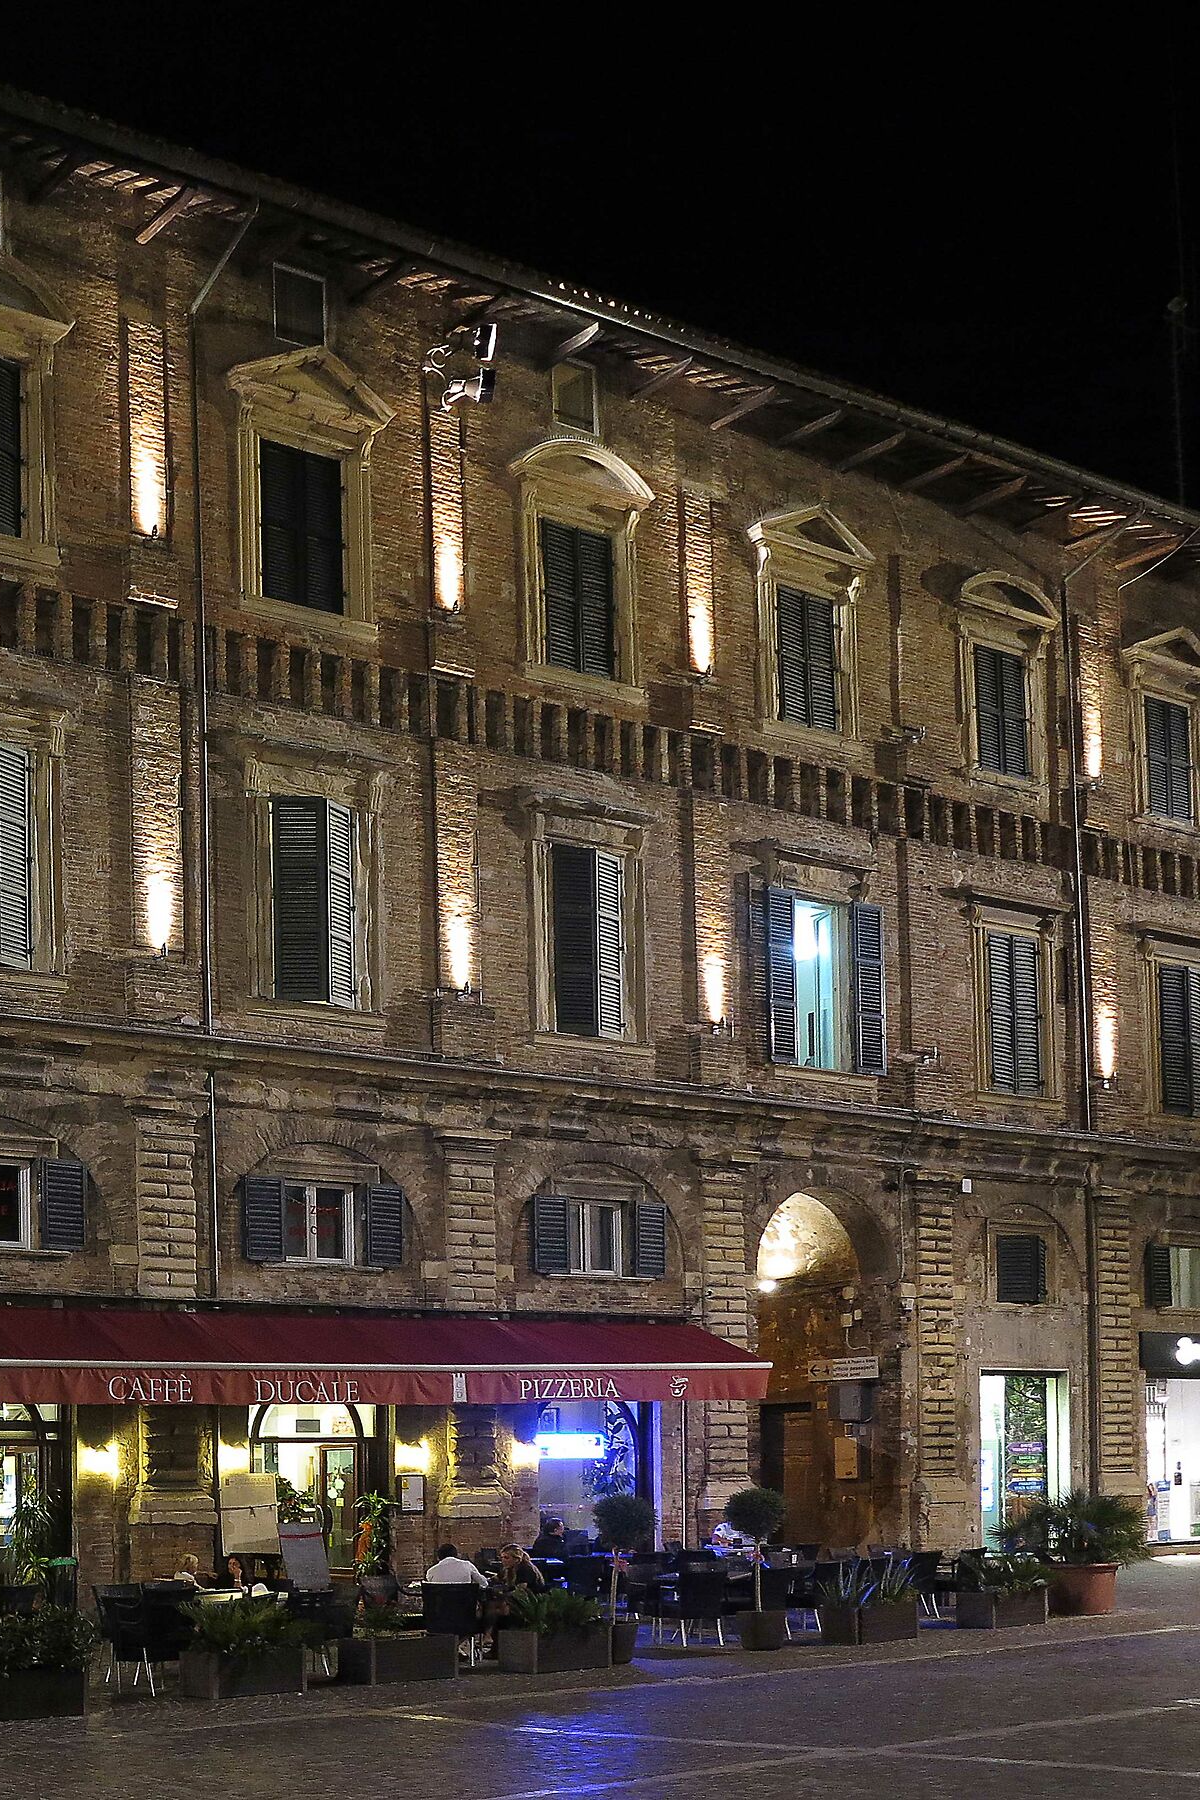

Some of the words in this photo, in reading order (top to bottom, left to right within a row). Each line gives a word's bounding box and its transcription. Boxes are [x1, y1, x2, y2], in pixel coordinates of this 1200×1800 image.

[108, 1374, 194, 1402] CAFFÈ
[256, 1379, 360, 1403] DUCALE
[520, 1378, 620, 1400] PIZZERIA
